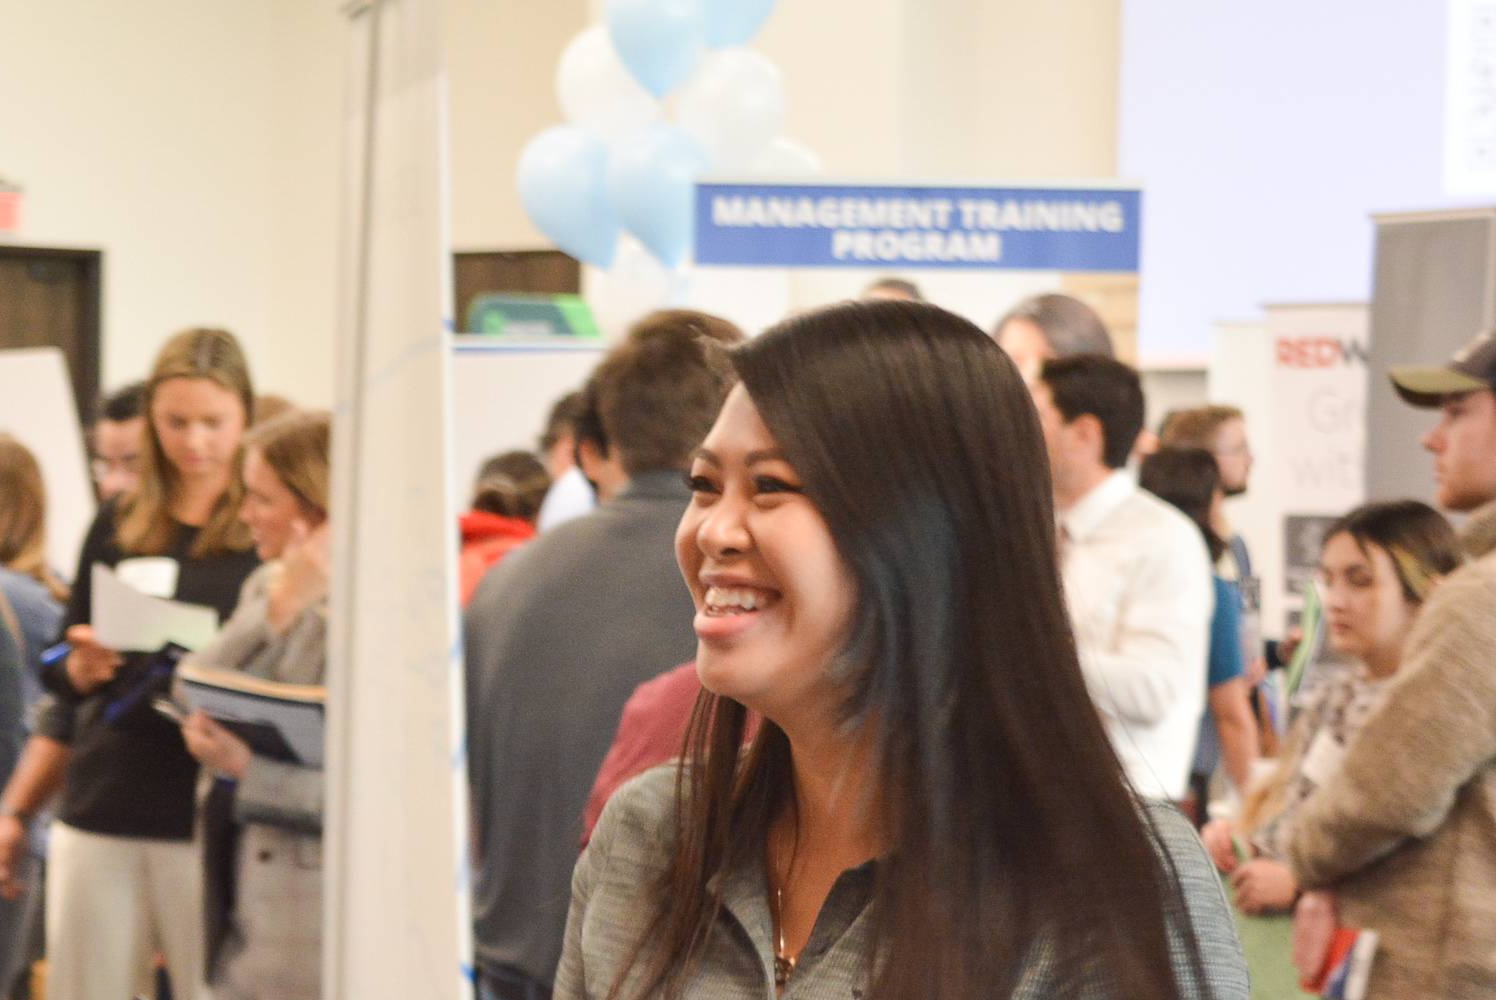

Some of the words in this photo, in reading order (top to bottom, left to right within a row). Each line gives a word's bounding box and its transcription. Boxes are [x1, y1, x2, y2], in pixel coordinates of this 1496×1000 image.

[712, 195, 952, 231] MANAGEMENT
[960, 200, 1124, 232] TRAINING
[831, 230, 1002, 262] PROGRAM
